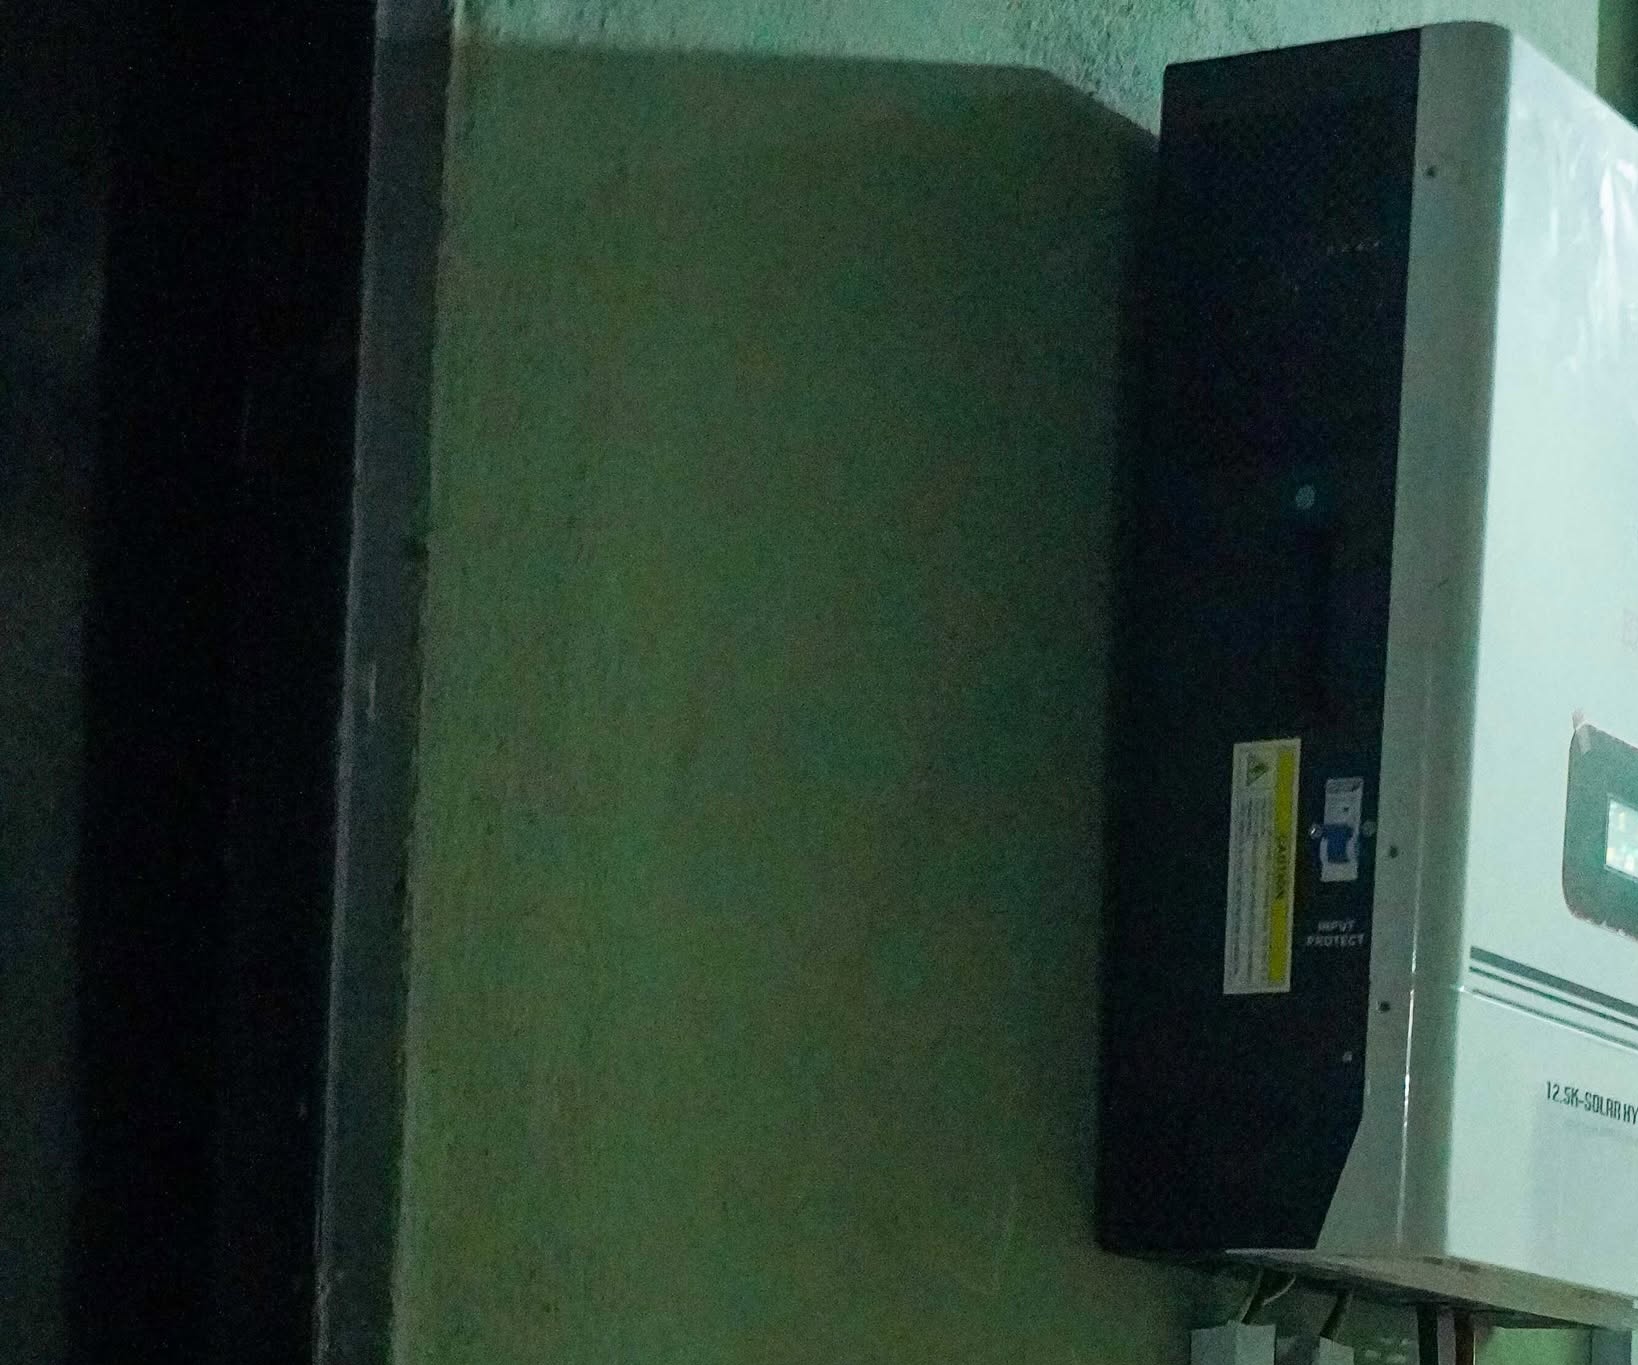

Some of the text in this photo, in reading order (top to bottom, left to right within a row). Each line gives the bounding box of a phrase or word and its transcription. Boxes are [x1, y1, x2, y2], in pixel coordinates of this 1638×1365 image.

[1318, 920, 1356, 932] INPUT
[1306, 933, 1364, 947] PROTECT
[1546, 1081, 1621, 1120] 12.5K-SOLAR
